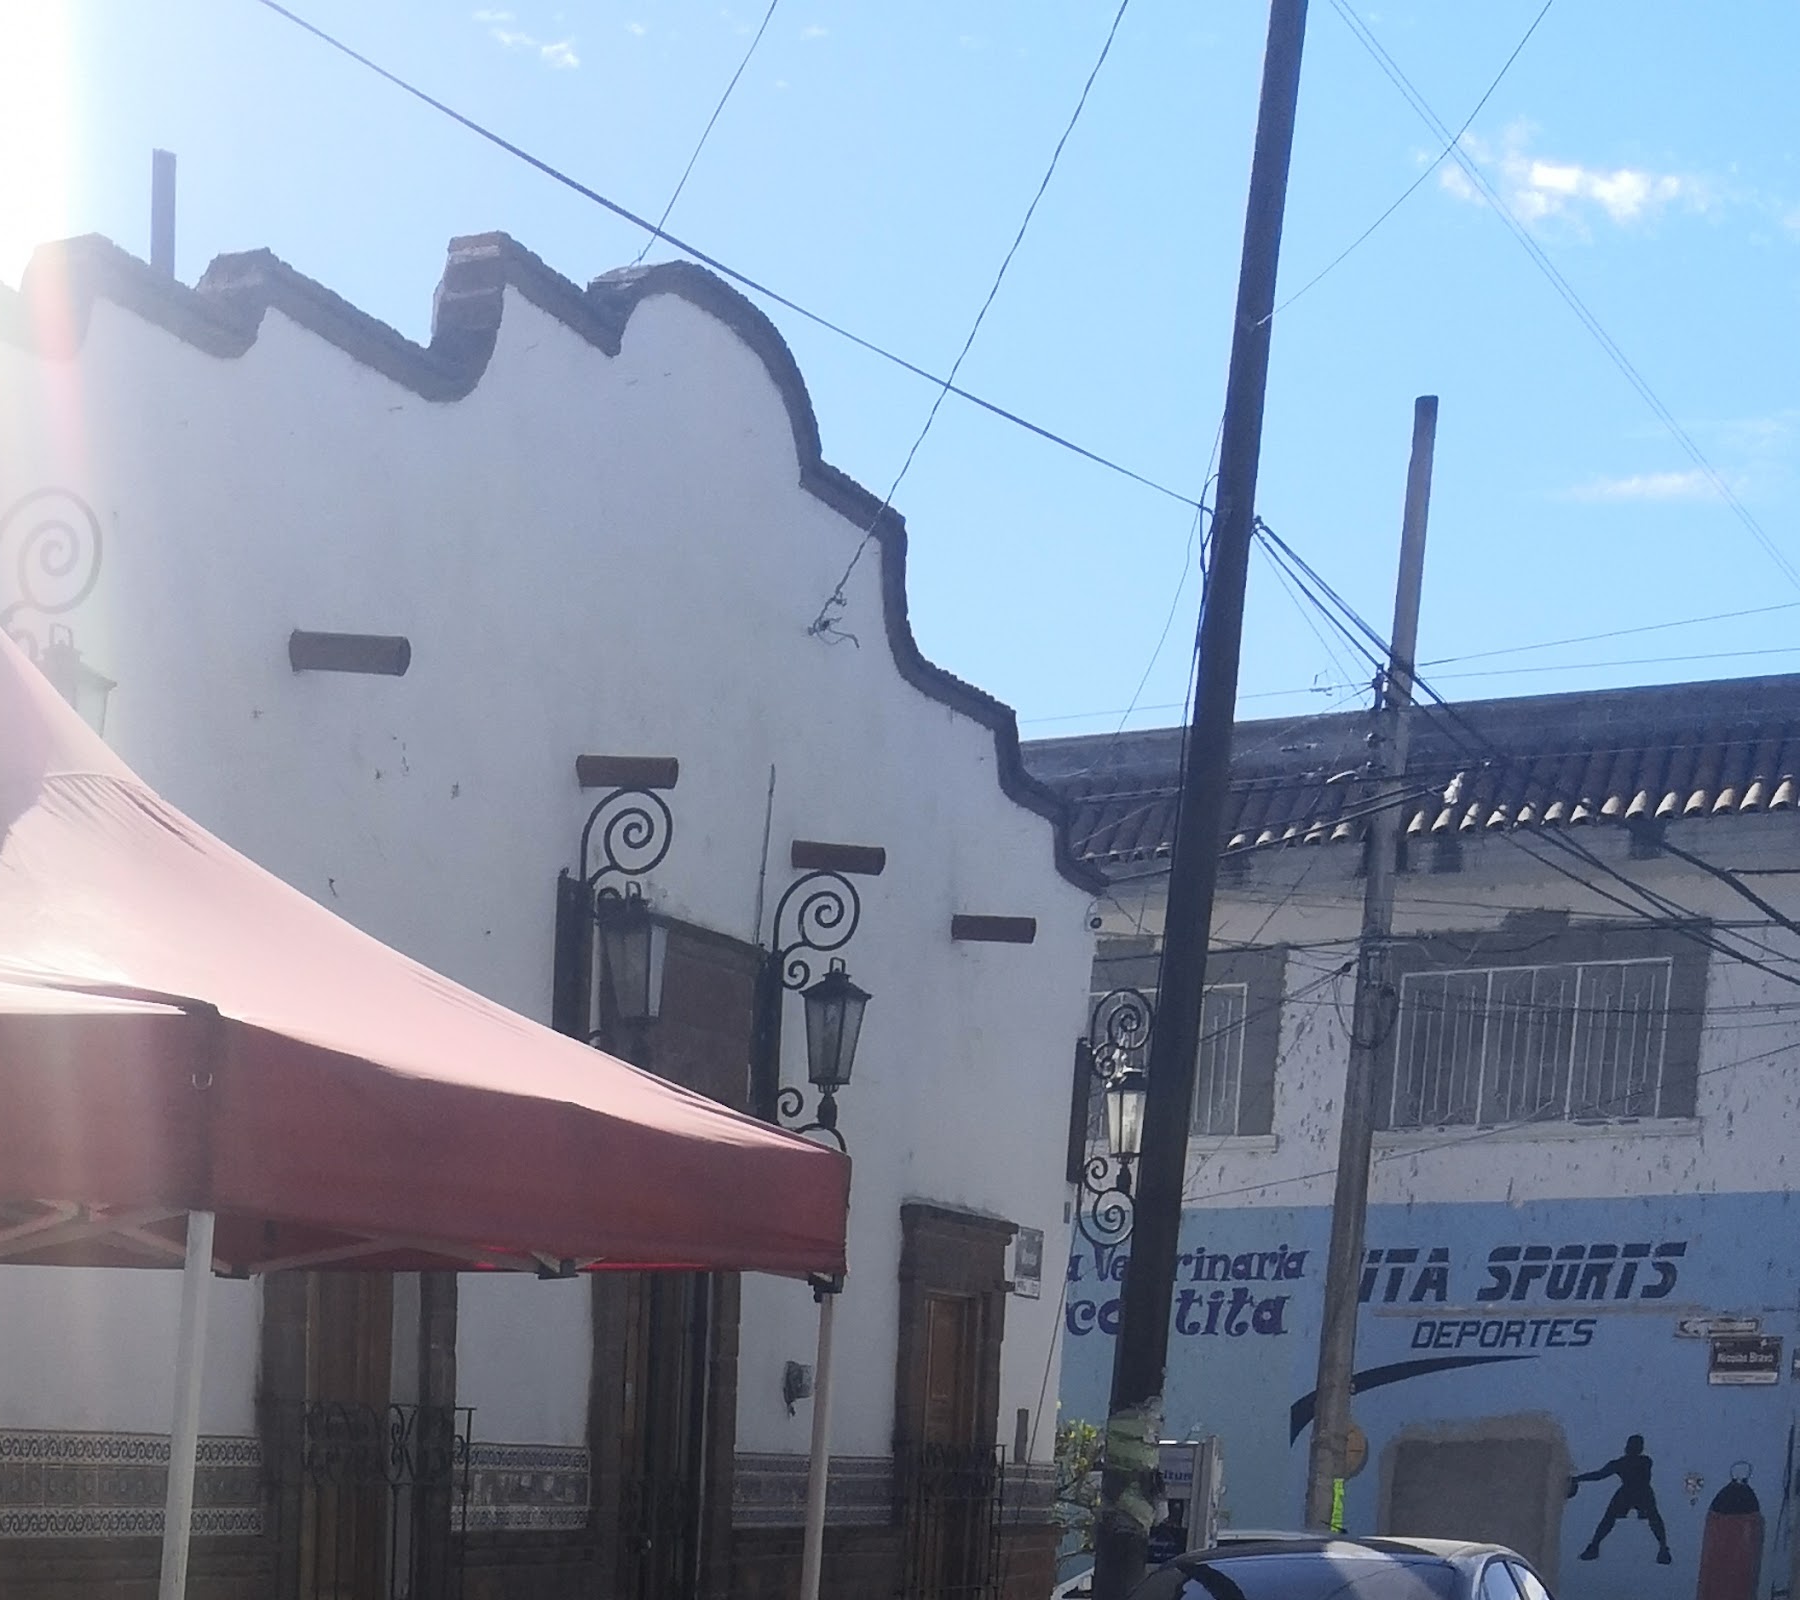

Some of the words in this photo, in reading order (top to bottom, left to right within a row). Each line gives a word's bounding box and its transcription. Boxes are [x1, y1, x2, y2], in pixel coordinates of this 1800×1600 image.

[1093, 1243, 1311, 1282] Verinaria
[1358, 1248, 1450, 1302] ITA
[1477, 1242, 1688, 1301] SPORTS
[1411, 1319, 1598, 1349] DEPORTES
